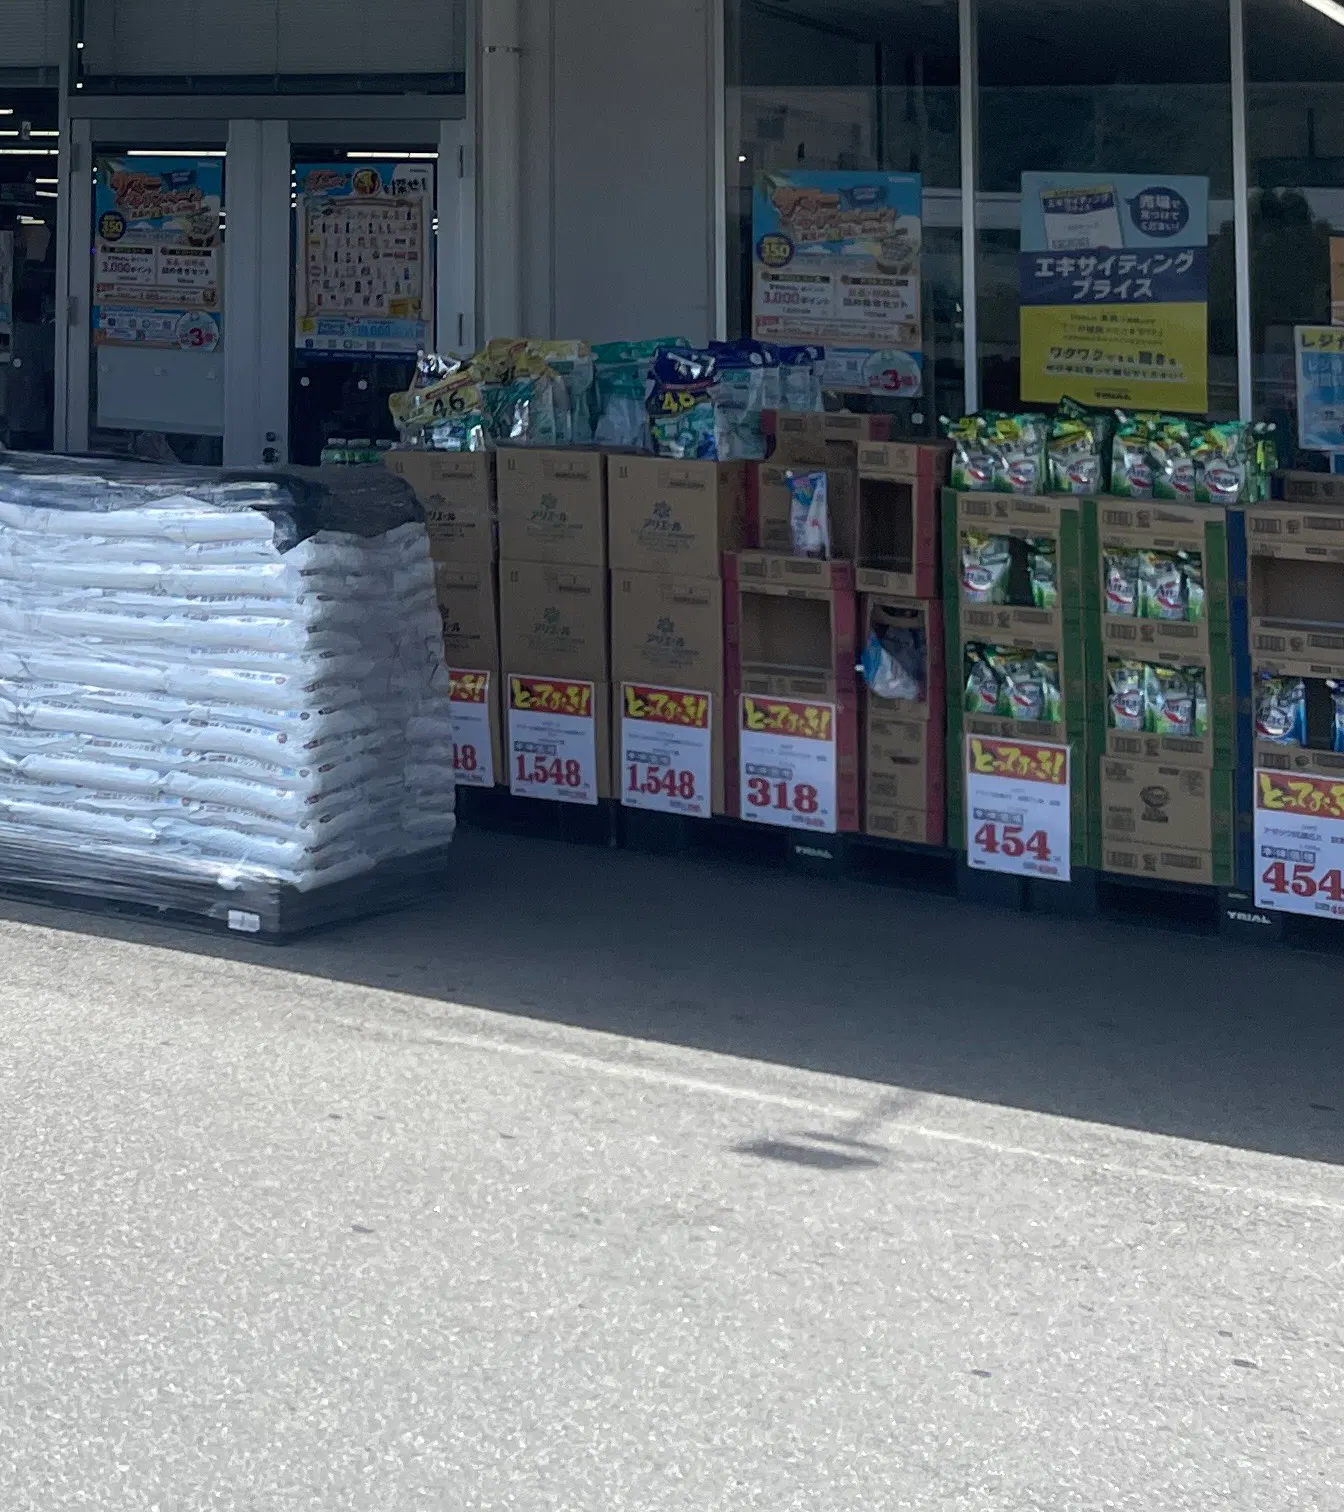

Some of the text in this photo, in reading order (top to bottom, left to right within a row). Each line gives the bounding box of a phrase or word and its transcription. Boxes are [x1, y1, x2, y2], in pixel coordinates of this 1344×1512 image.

[1034, 249, 1195, 278] エキサイティング
[1072, 277, 1152, 300] プライス
[516, 752, 581, 787] 1,548
[627, 763, 695, 800] 1,548
[747, 777, 819, 814] 318
[974, 822, 1052, 861] 454
[1262, 861, 1344, 902] 454
